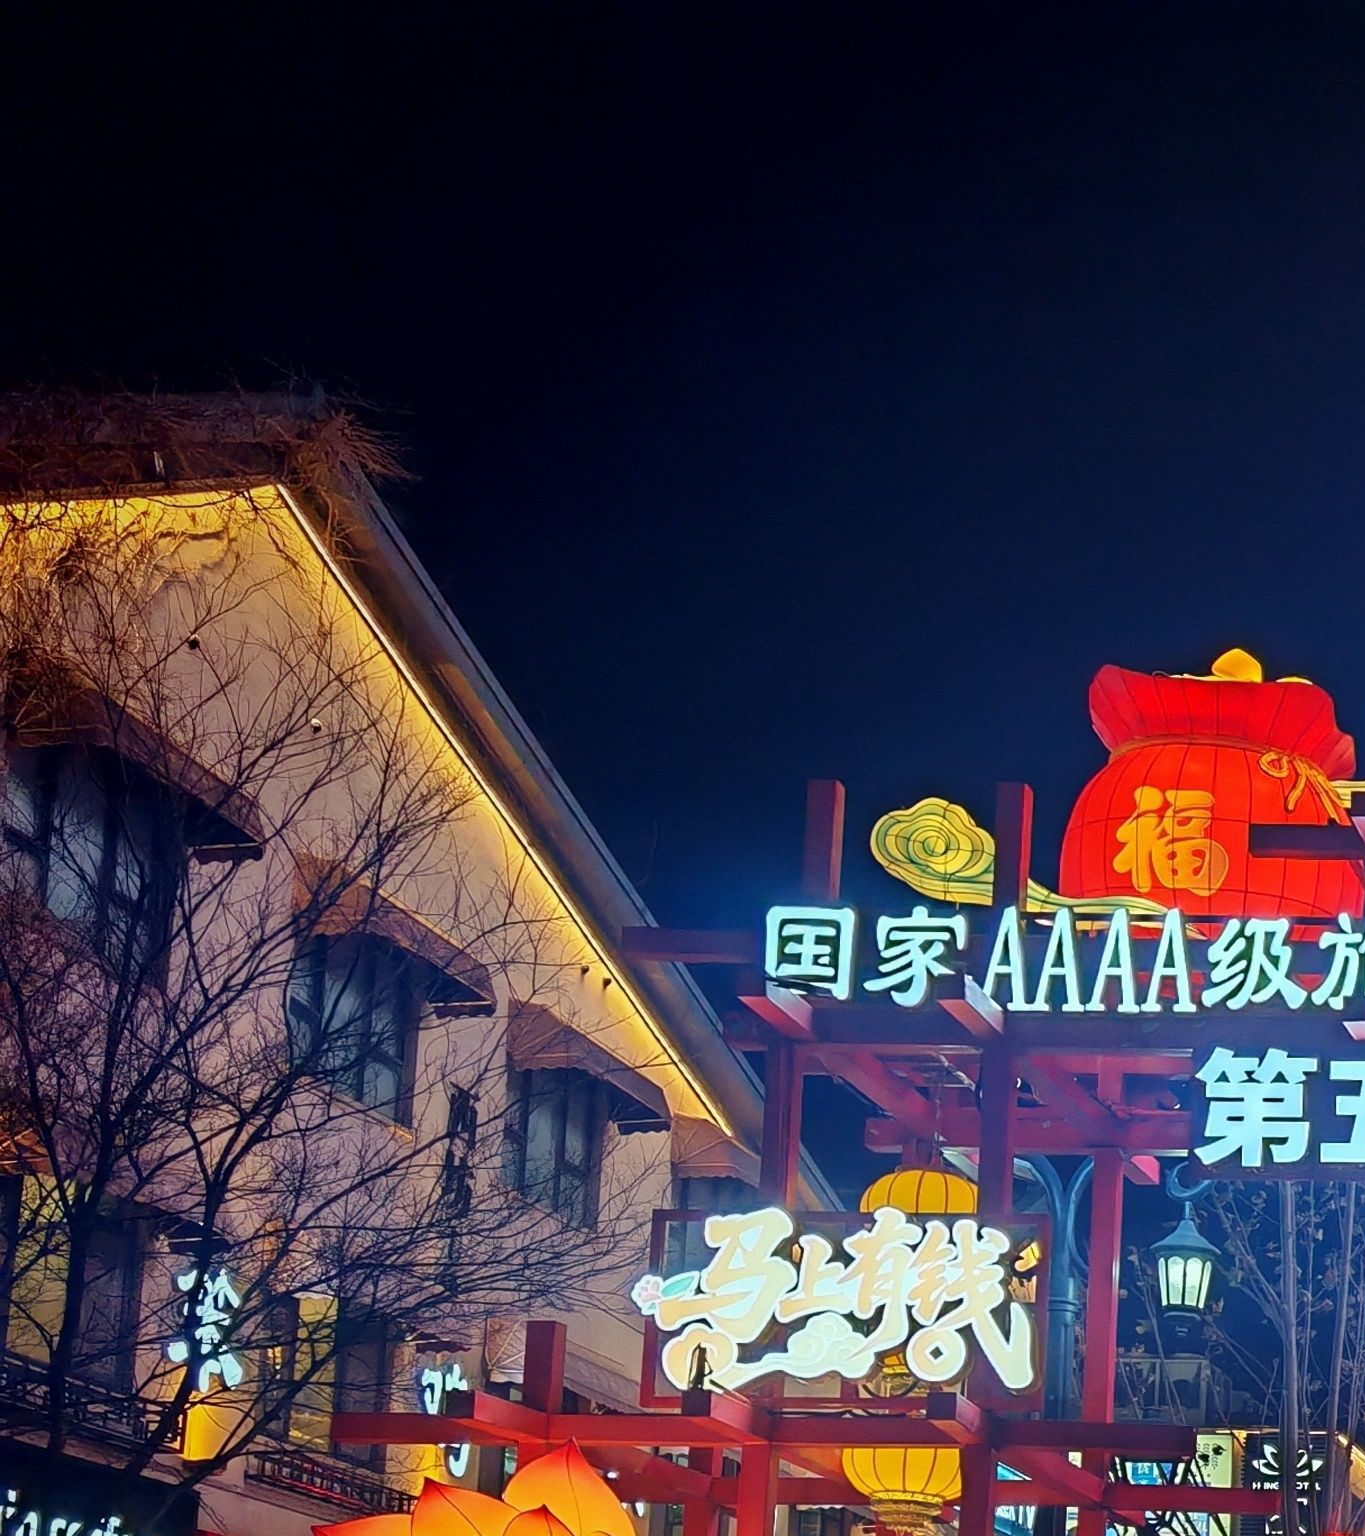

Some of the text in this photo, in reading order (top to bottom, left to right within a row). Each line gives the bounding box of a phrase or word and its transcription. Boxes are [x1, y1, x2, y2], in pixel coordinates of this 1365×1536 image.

[1112, 786, 1231, 897] 福
[656, 1206, 1035, 1390] 马上有钱
